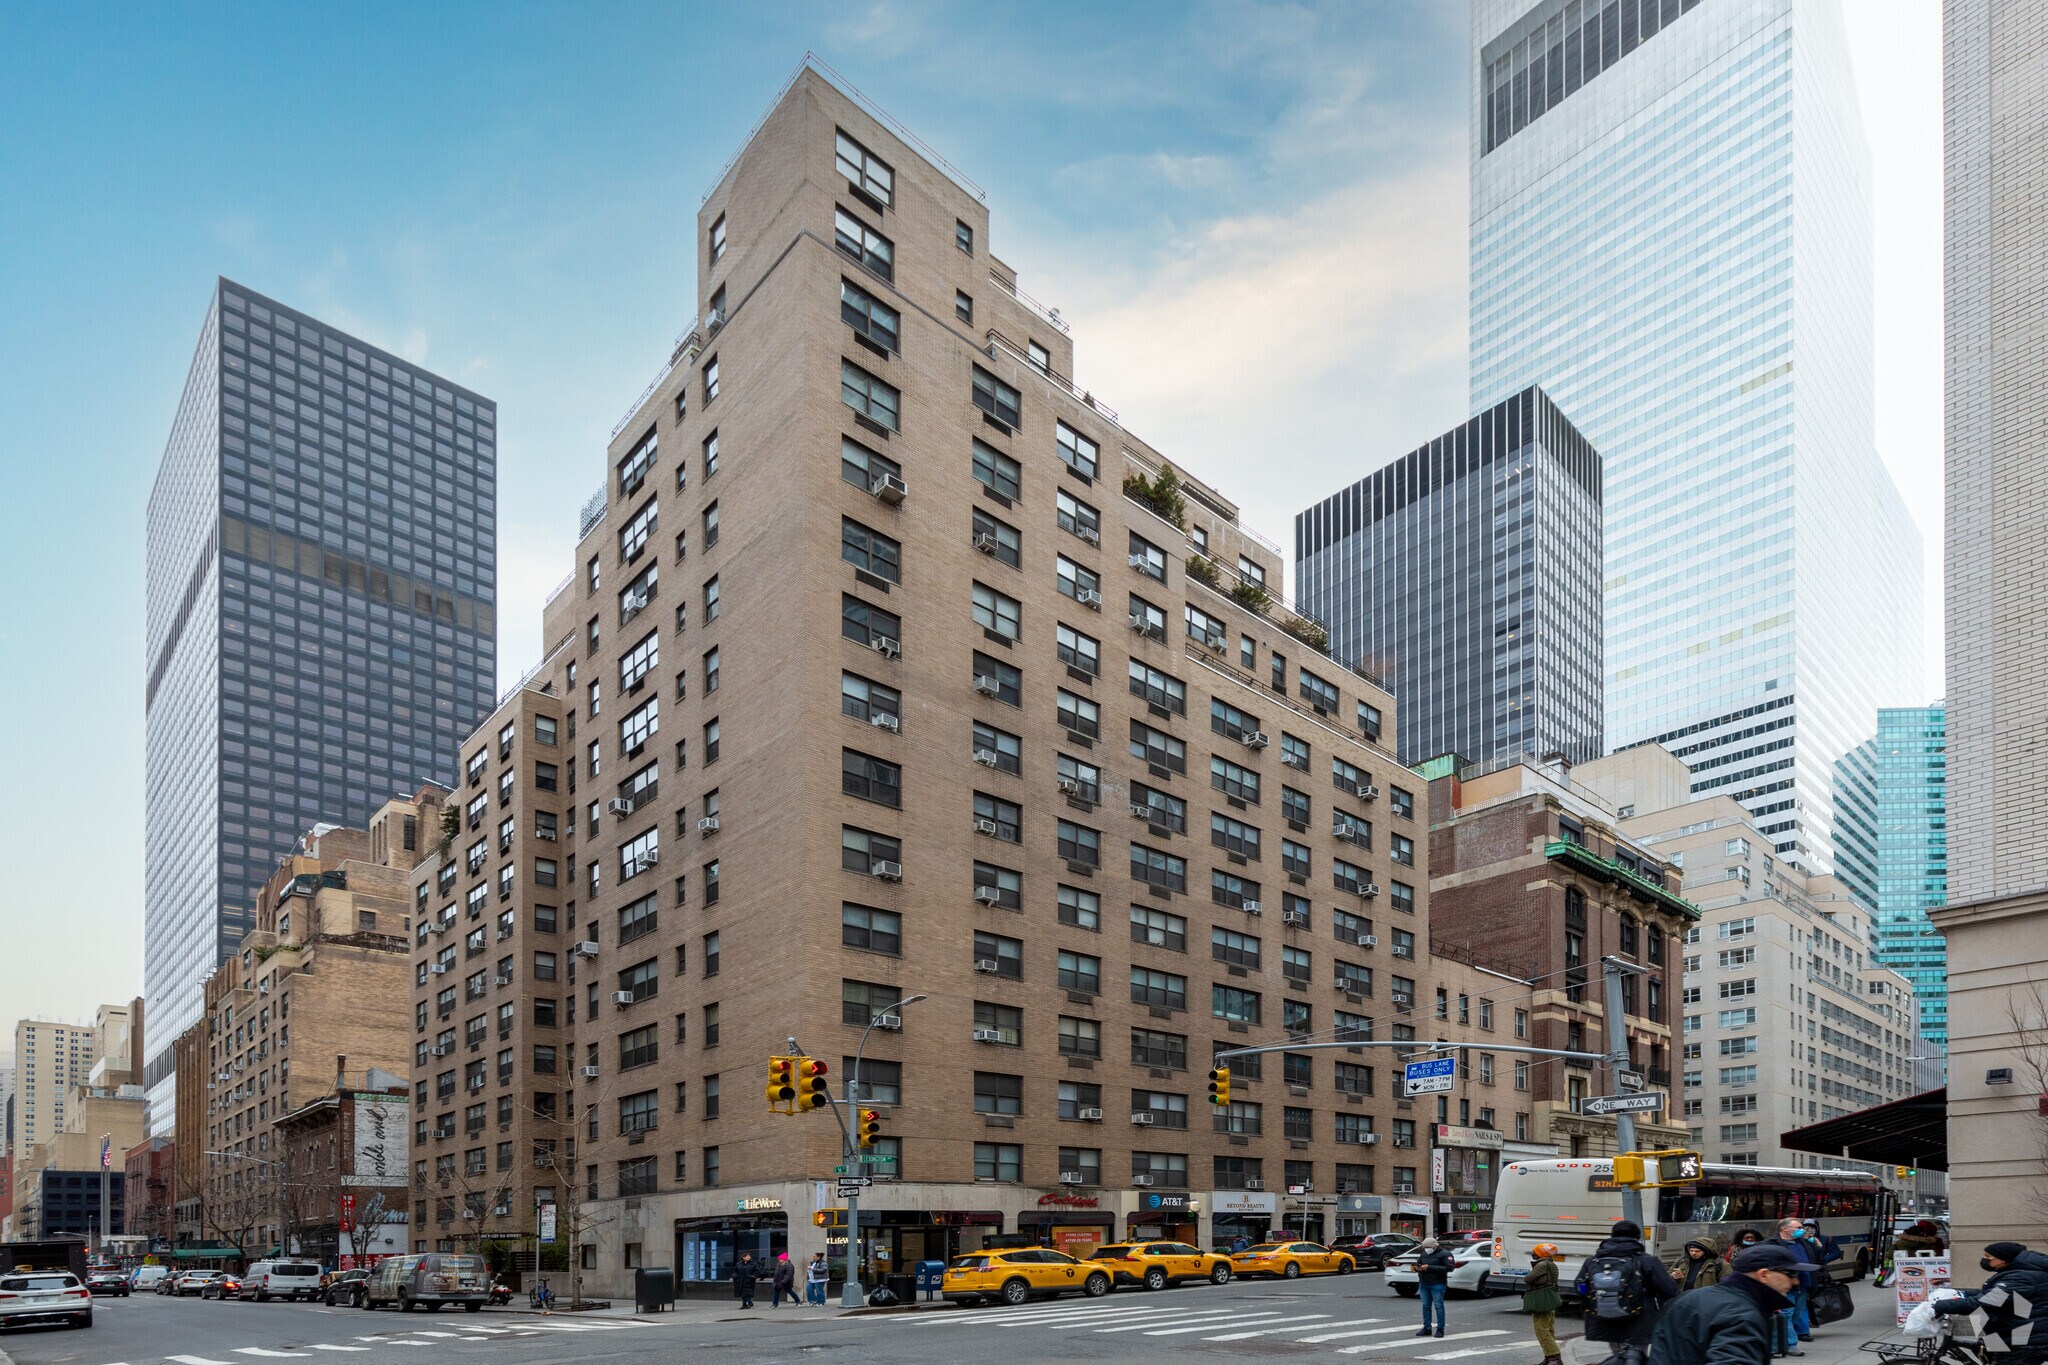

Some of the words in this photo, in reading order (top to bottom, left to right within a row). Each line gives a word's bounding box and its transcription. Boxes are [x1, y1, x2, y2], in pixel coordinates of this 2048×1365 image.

[1434, 1060, 1450, 1068] LANE
[1409, 1068, 1431, 1076] BUSES
[1433, 1065, 1451, 1073] ONLY
[1622, 1075, 1632, 1084] ONE
[1593, 1101, 1616, 1111] ONE
[1626, 1098, 1651, 1107] WAY
[1474, 1131, 1489, 1140] NAILS
[1493, 1132, 1503, 1141] SPA
[745, 1197, 782, 1210] LifeWorx
[1039, 1192, 1098, 1207] Cellini
[1161, 1197, 1183, 1207] AT&T
[1457, 1202, 1471, 1210] UNI
[1478, 1202, 1492, 1210] WAX
[1932, 1266, 1948, 1275] $8
